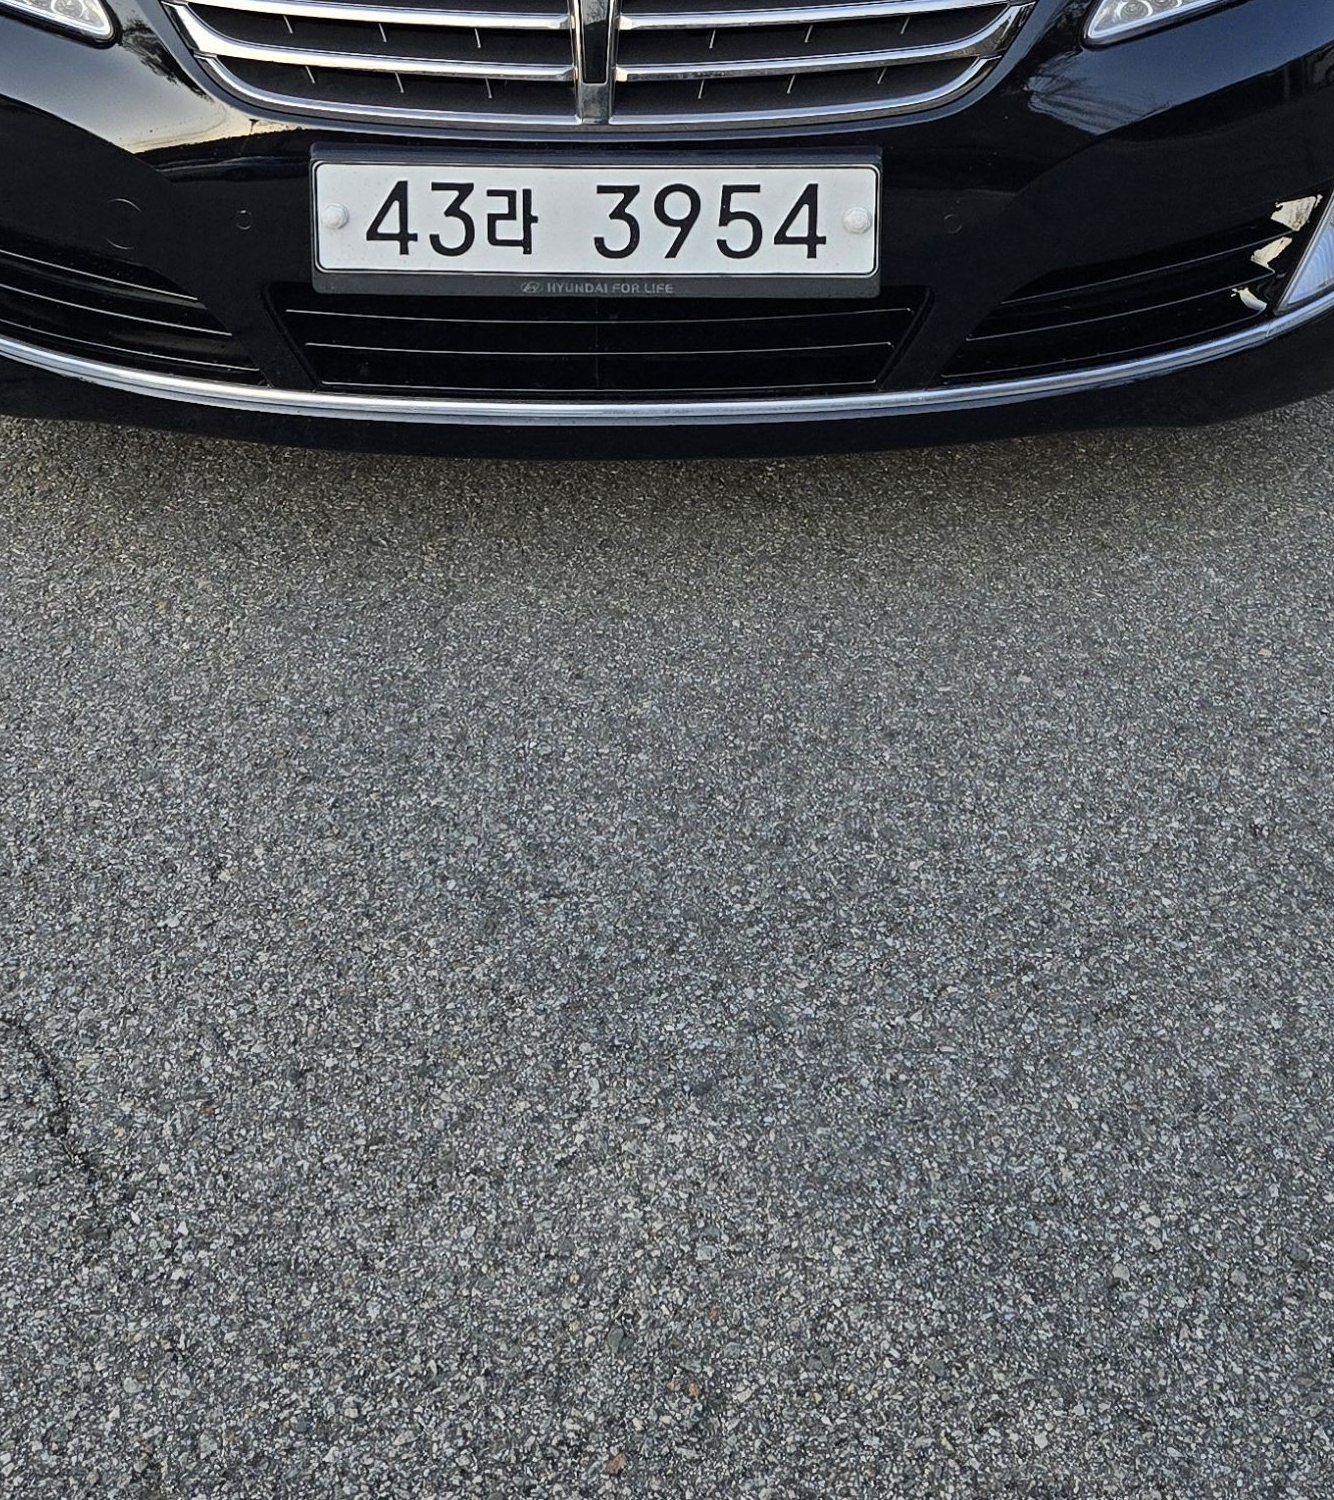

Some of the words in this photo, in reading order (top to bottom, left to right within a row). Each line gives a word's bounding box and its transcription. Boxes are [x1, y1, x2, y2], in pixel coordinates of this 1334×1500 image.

[366, 180, 539, 257] 43라
[593, 183, 827, 260] 3954
[547, 282, 608, 294] HYUNDAI
[612, 282, 640, 294] FOR
[644, 282, 674, 294] LIFE
